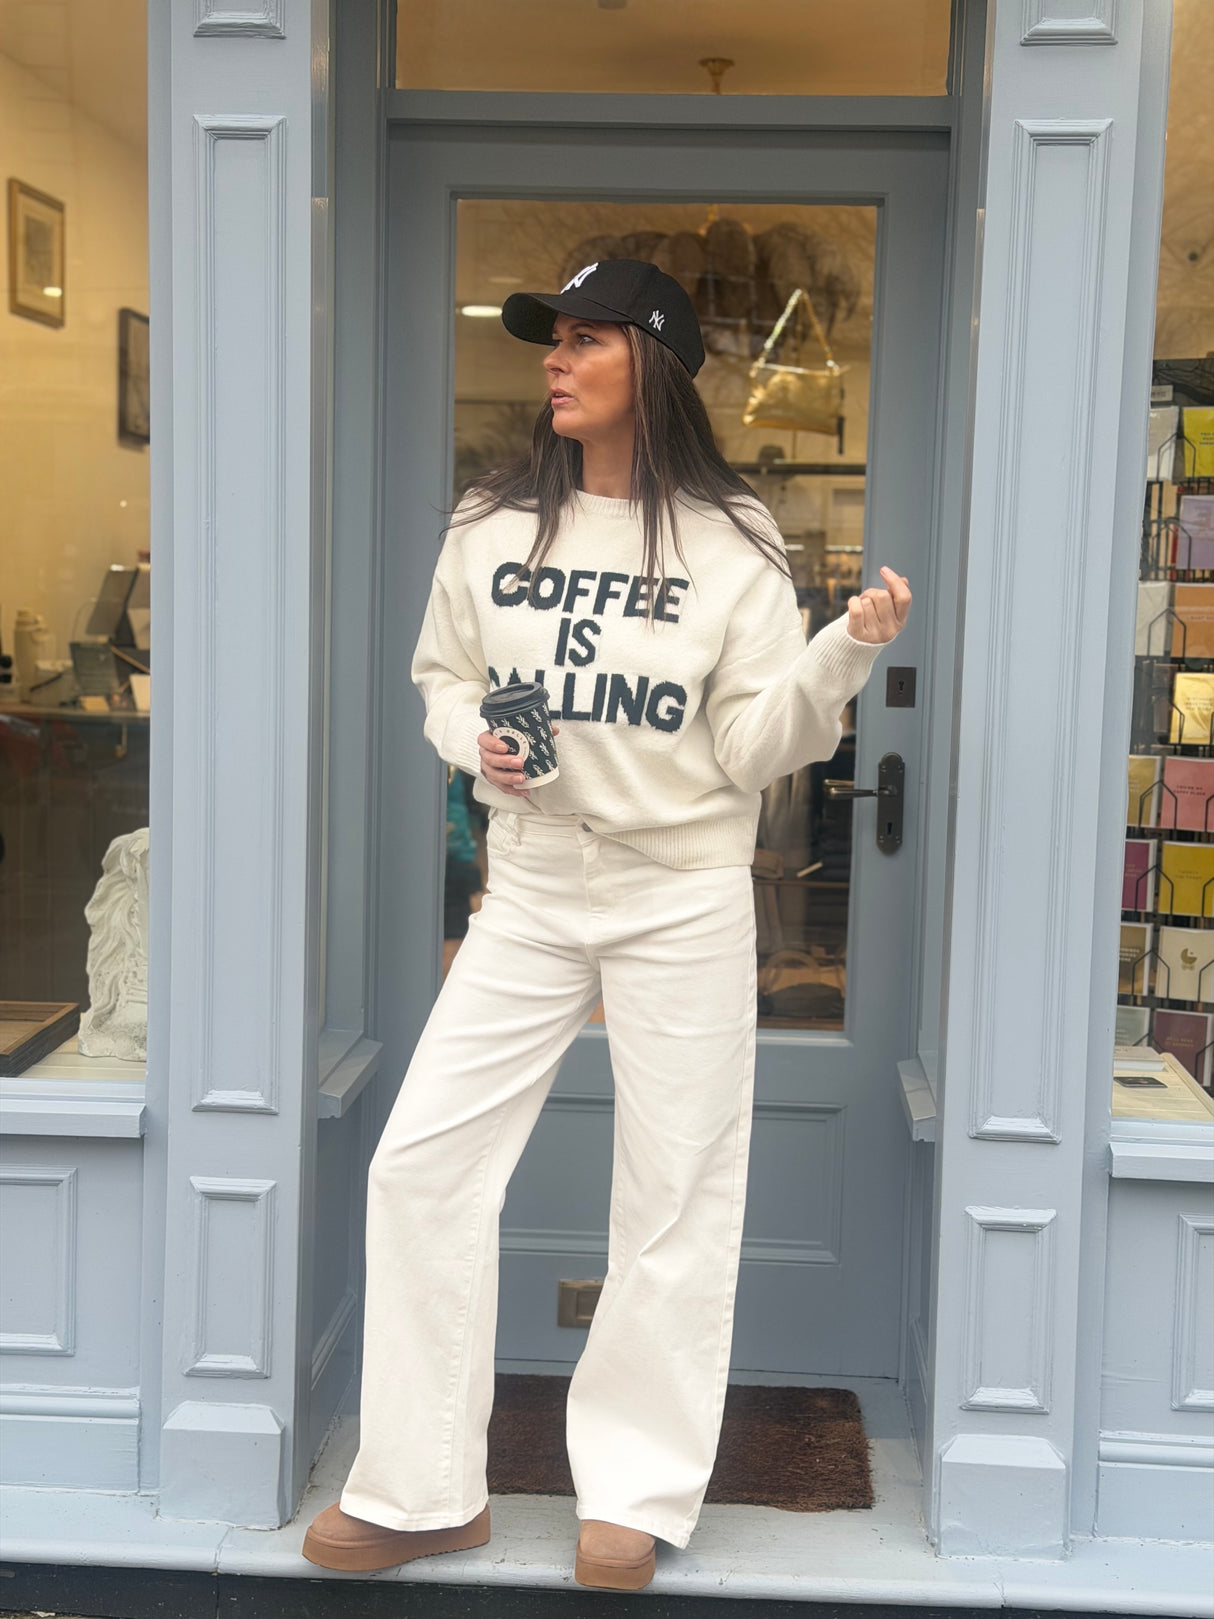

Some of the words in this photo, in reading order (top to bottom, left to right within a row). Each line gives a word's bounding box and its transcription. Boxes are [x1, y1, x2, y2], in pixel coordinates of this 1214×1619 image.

[648, 310, 665, 331] NY
[491, 561, 690, 623] COFFEE
[554, 618, 601, 667] IS
[488, 666, 689, 733] LLING
